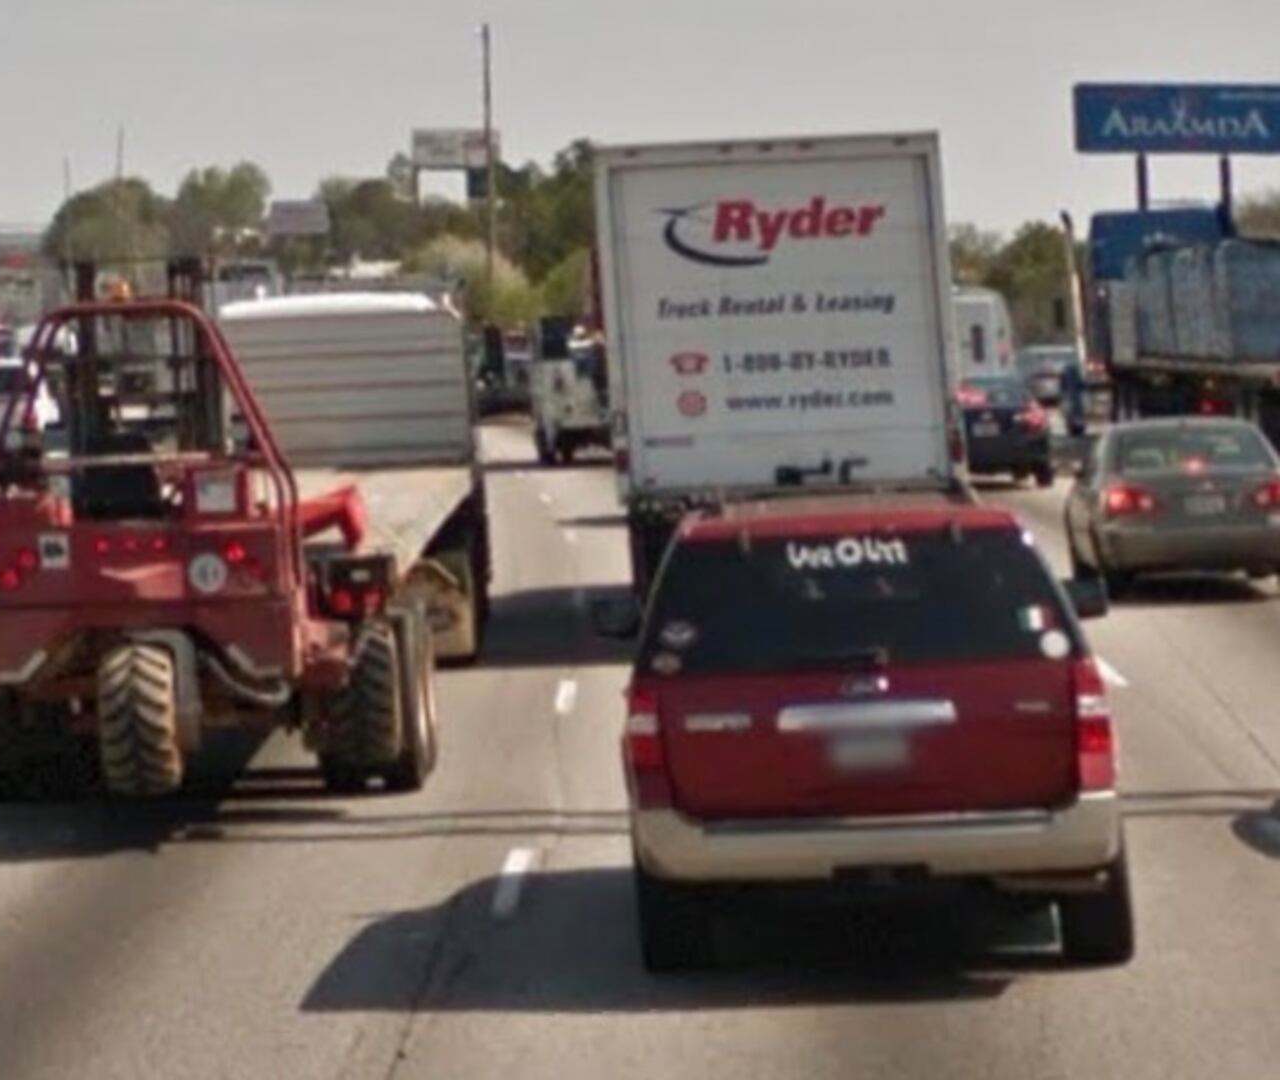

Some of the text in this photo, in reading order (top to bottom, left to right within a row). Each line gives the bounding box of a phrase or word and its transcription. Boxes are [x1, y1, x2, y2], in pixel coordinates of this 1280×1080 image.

[712, 195, 885, 251] Ryder
[657, 293, 896, 320] Truck Rental & Leasing
[726, 388, 894, 412] www.ryder.com
